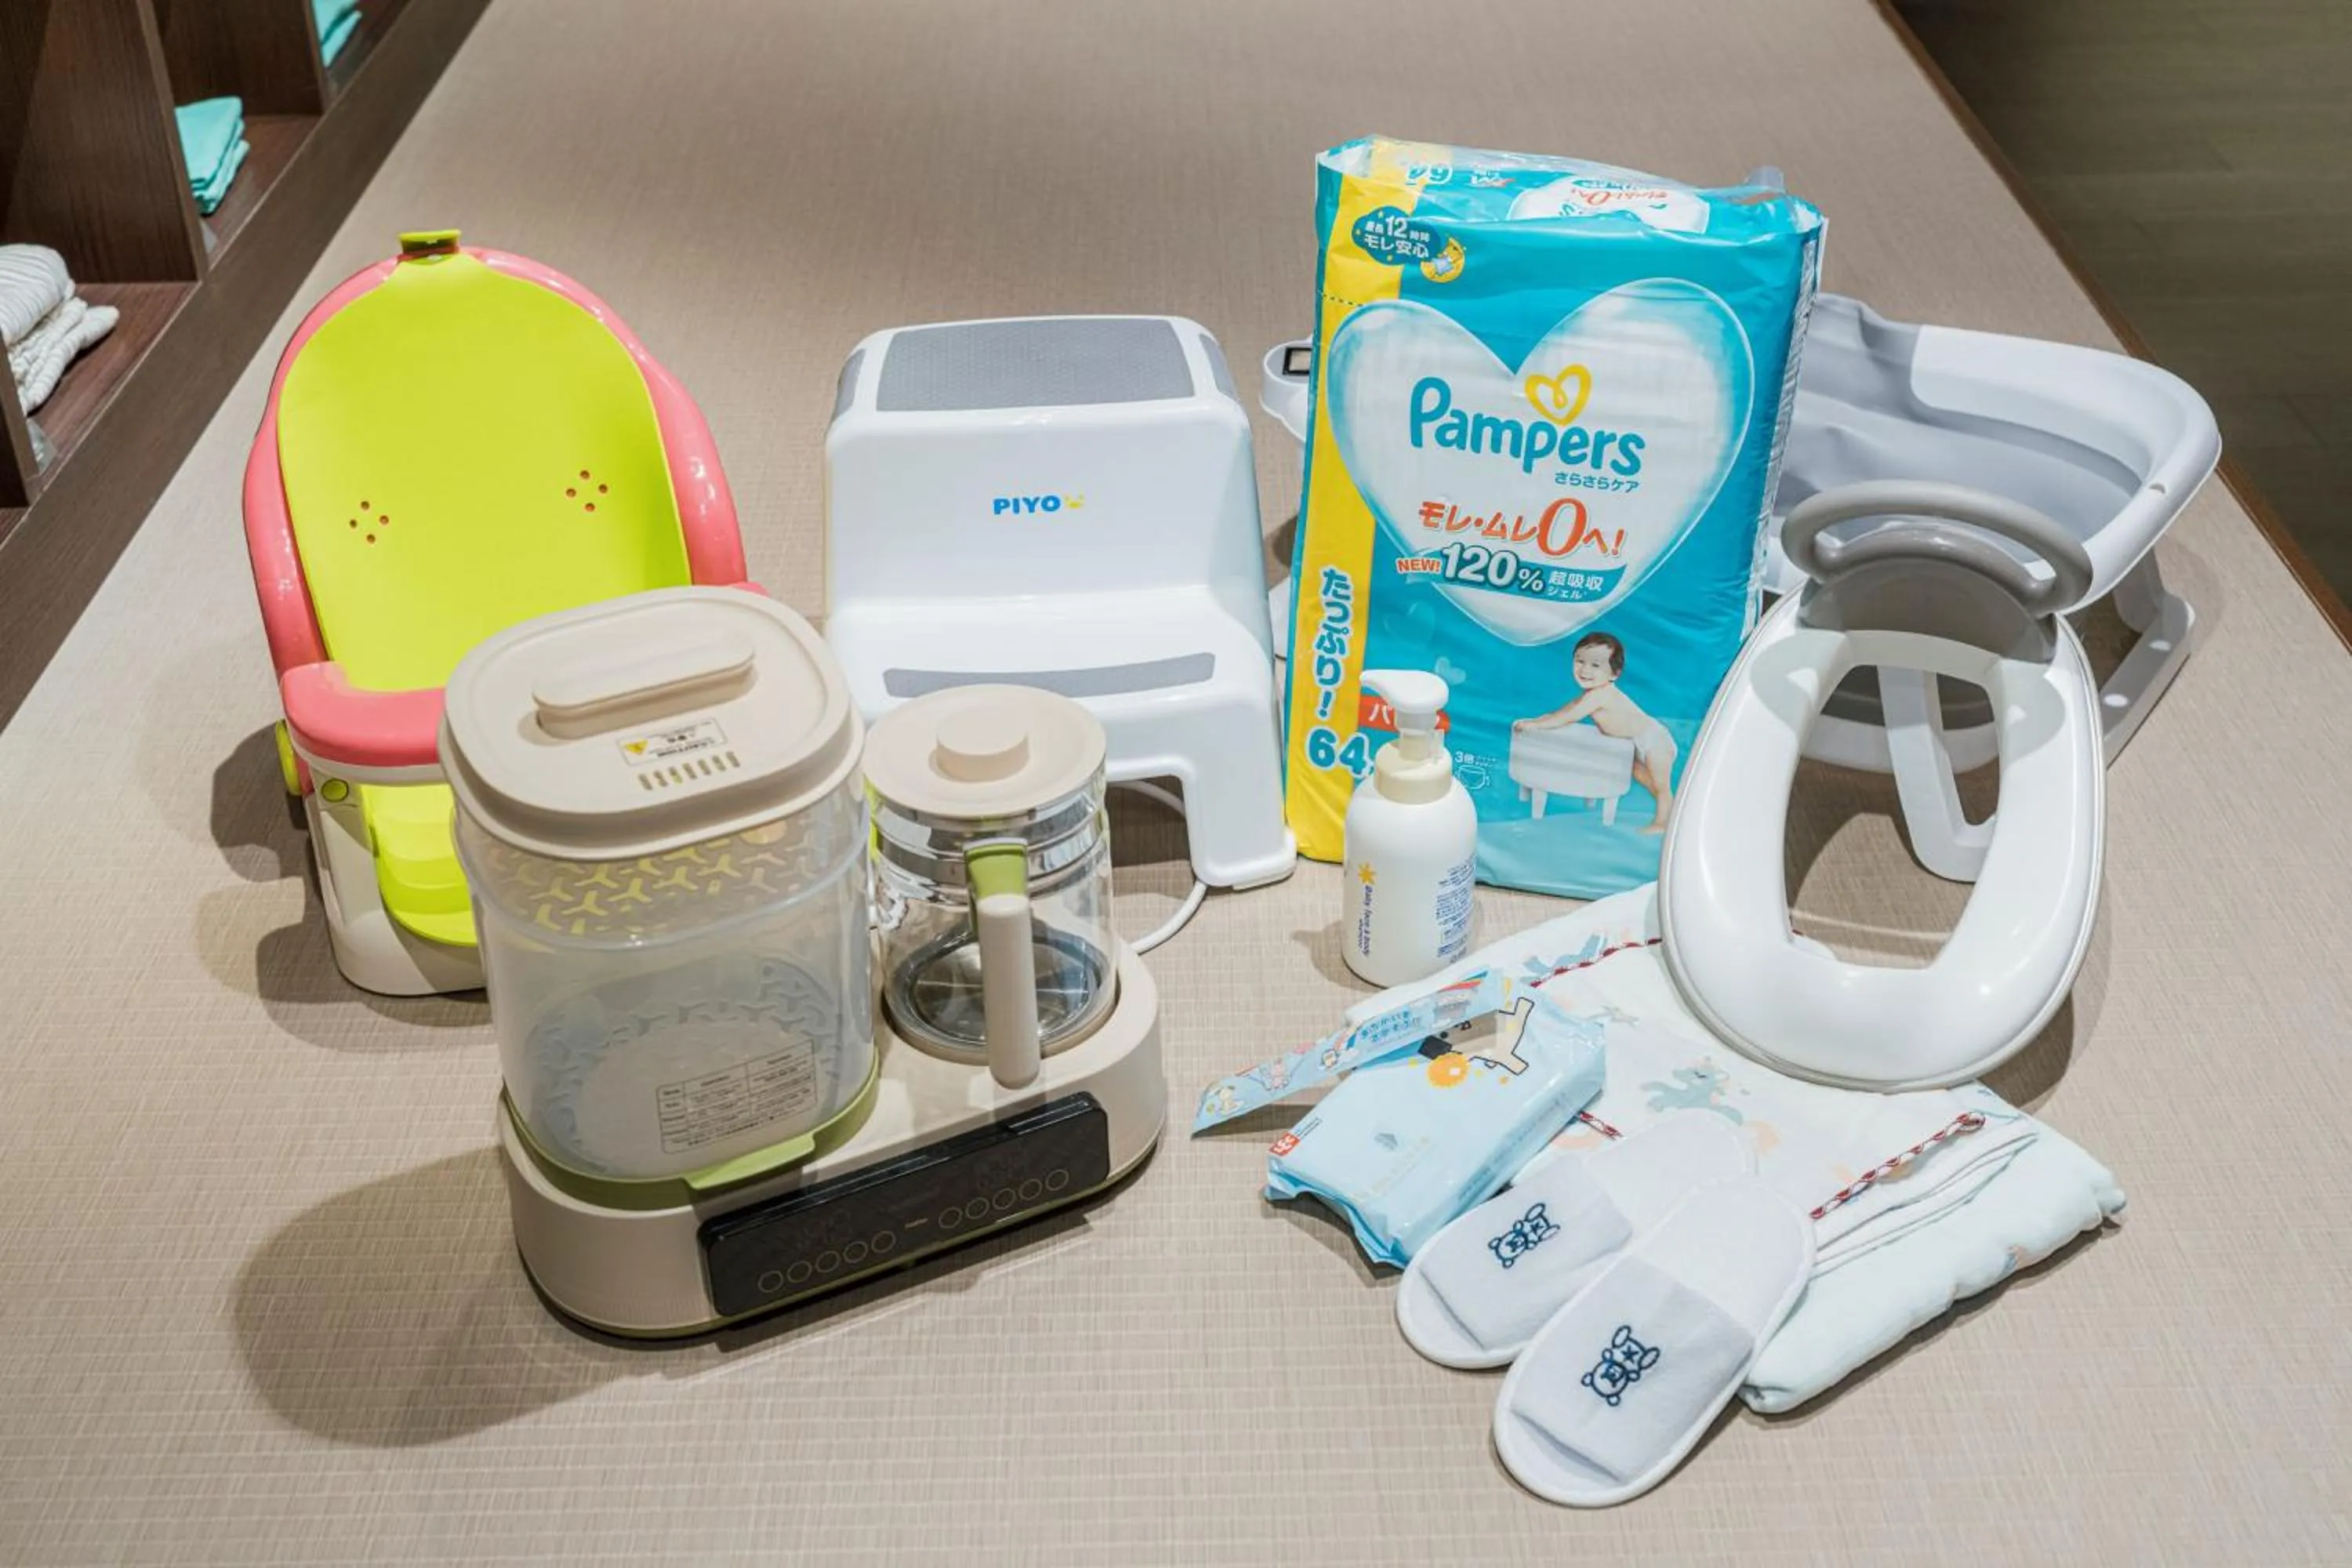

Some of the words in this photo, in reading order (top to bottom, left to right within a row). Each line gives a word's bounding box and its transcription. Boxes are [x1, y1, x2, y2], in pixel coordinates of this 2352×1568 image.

[1409, 376, 1646, 476] Pampers
[993, 495, 1061, 515] PIYO
[1555, 471, 1639, 493] さらさらケア
[1397, 557, 1440, 572] NEW!
[1442, 543, 1544, 592] 120%
[1308, 728, 1374, 776] 64
